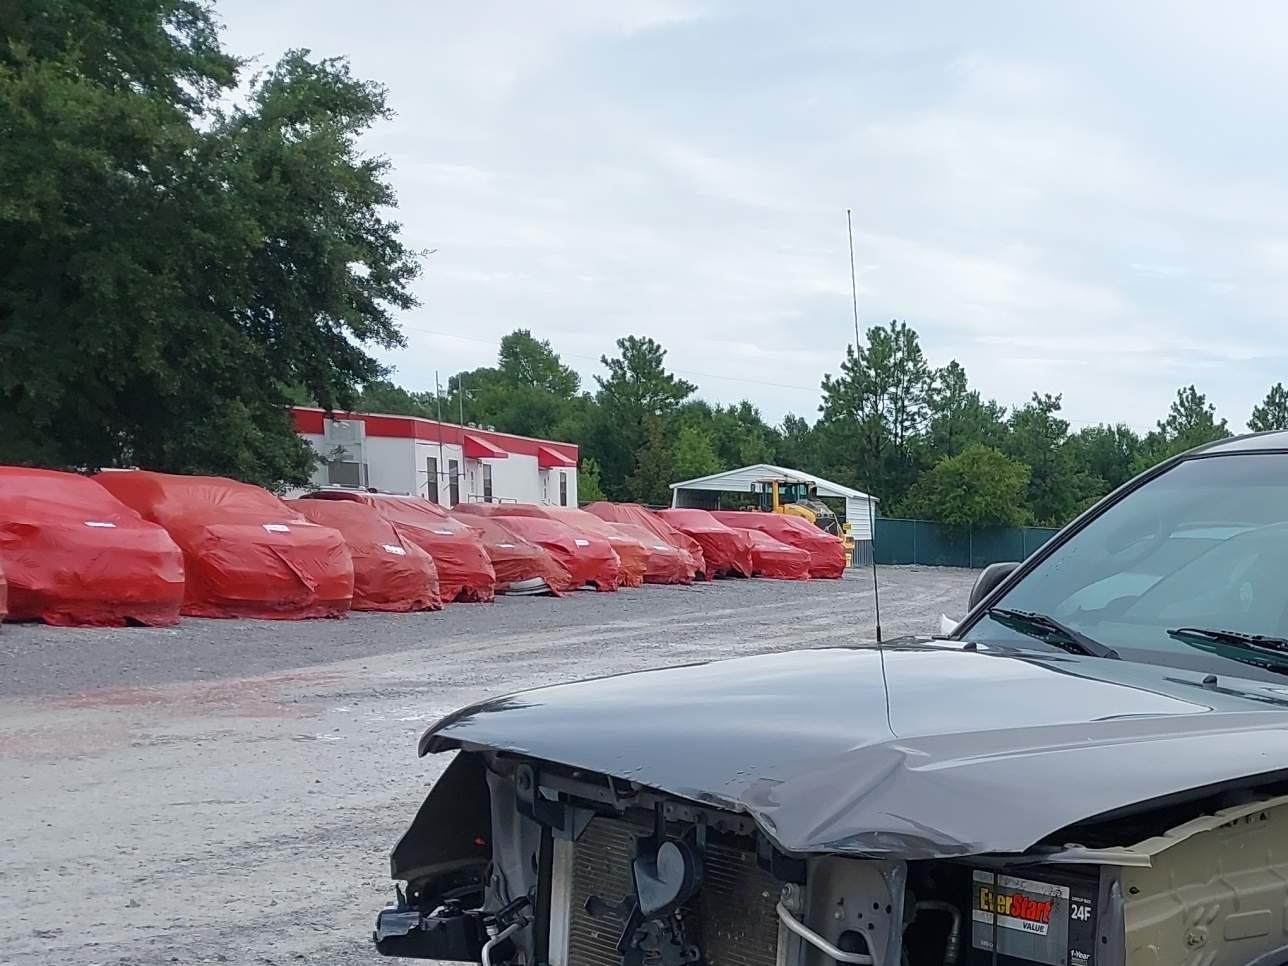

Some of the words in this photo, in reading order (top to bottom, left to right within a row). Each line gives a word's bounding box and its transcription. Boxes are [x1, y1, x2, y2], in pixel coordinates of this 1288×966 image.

[979, 887, 1052, 923] EverStart
[1071, 903, 1092, 921] 24F
[1023, 921, 1044, 932] VALUE
